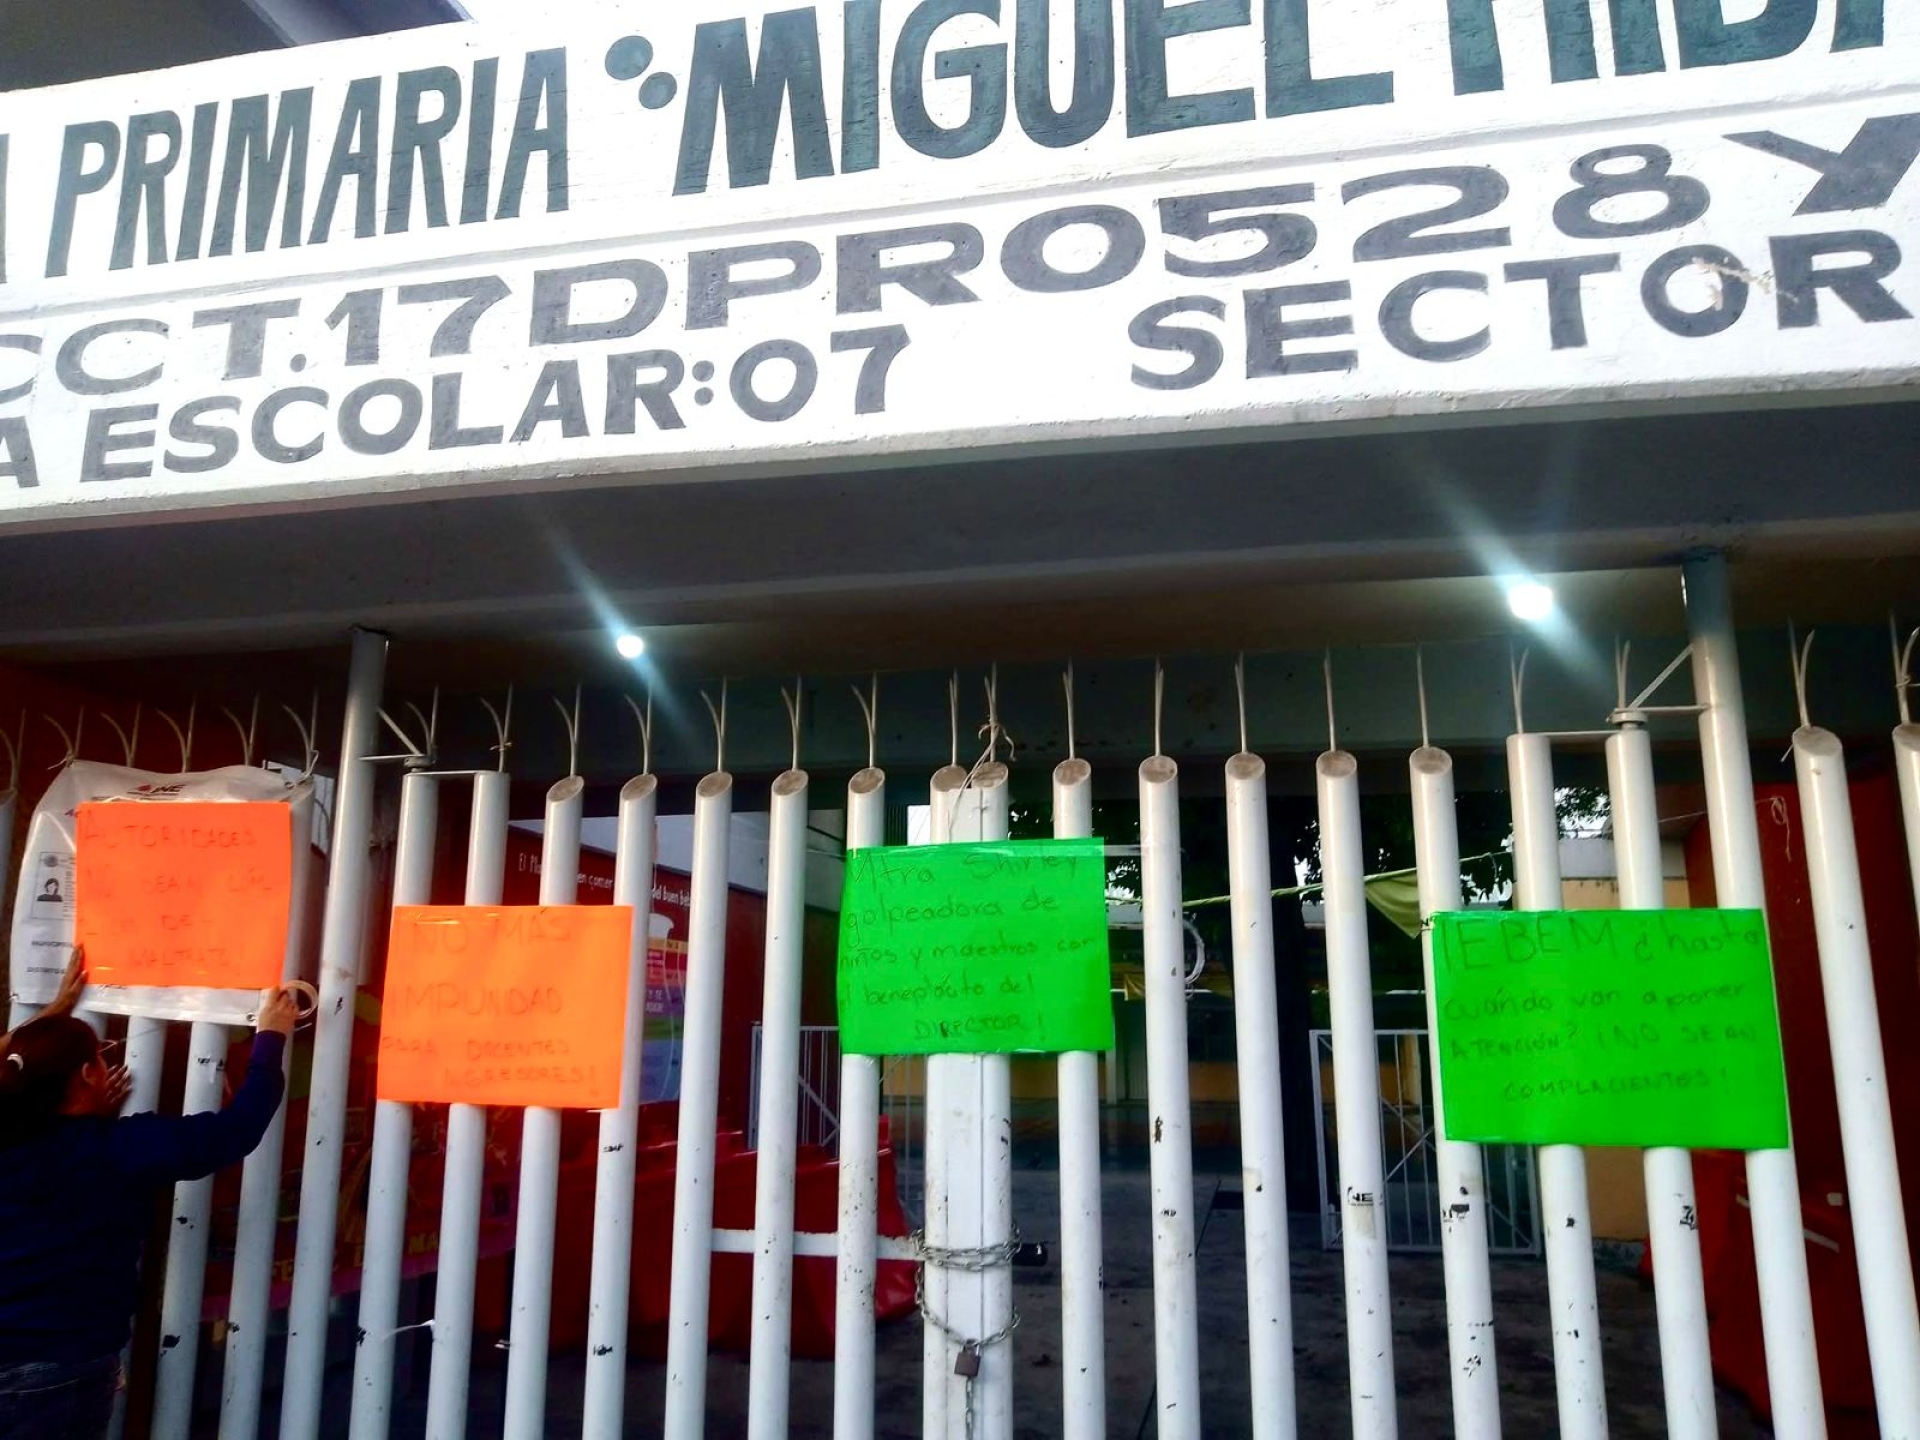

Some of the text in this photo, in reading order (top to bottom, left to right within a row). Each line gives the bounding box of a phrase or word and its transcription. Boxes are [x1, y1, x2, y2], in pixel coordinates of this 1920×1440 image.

[45, 47, 570, 278] PRIMARIA
[672, 0, 1394, 196] MIGUEL
[1127, 229, 1914, 390] SECTOR
[412, 917, 469, 955] NO
[1021, 883, 1059, 911] de
